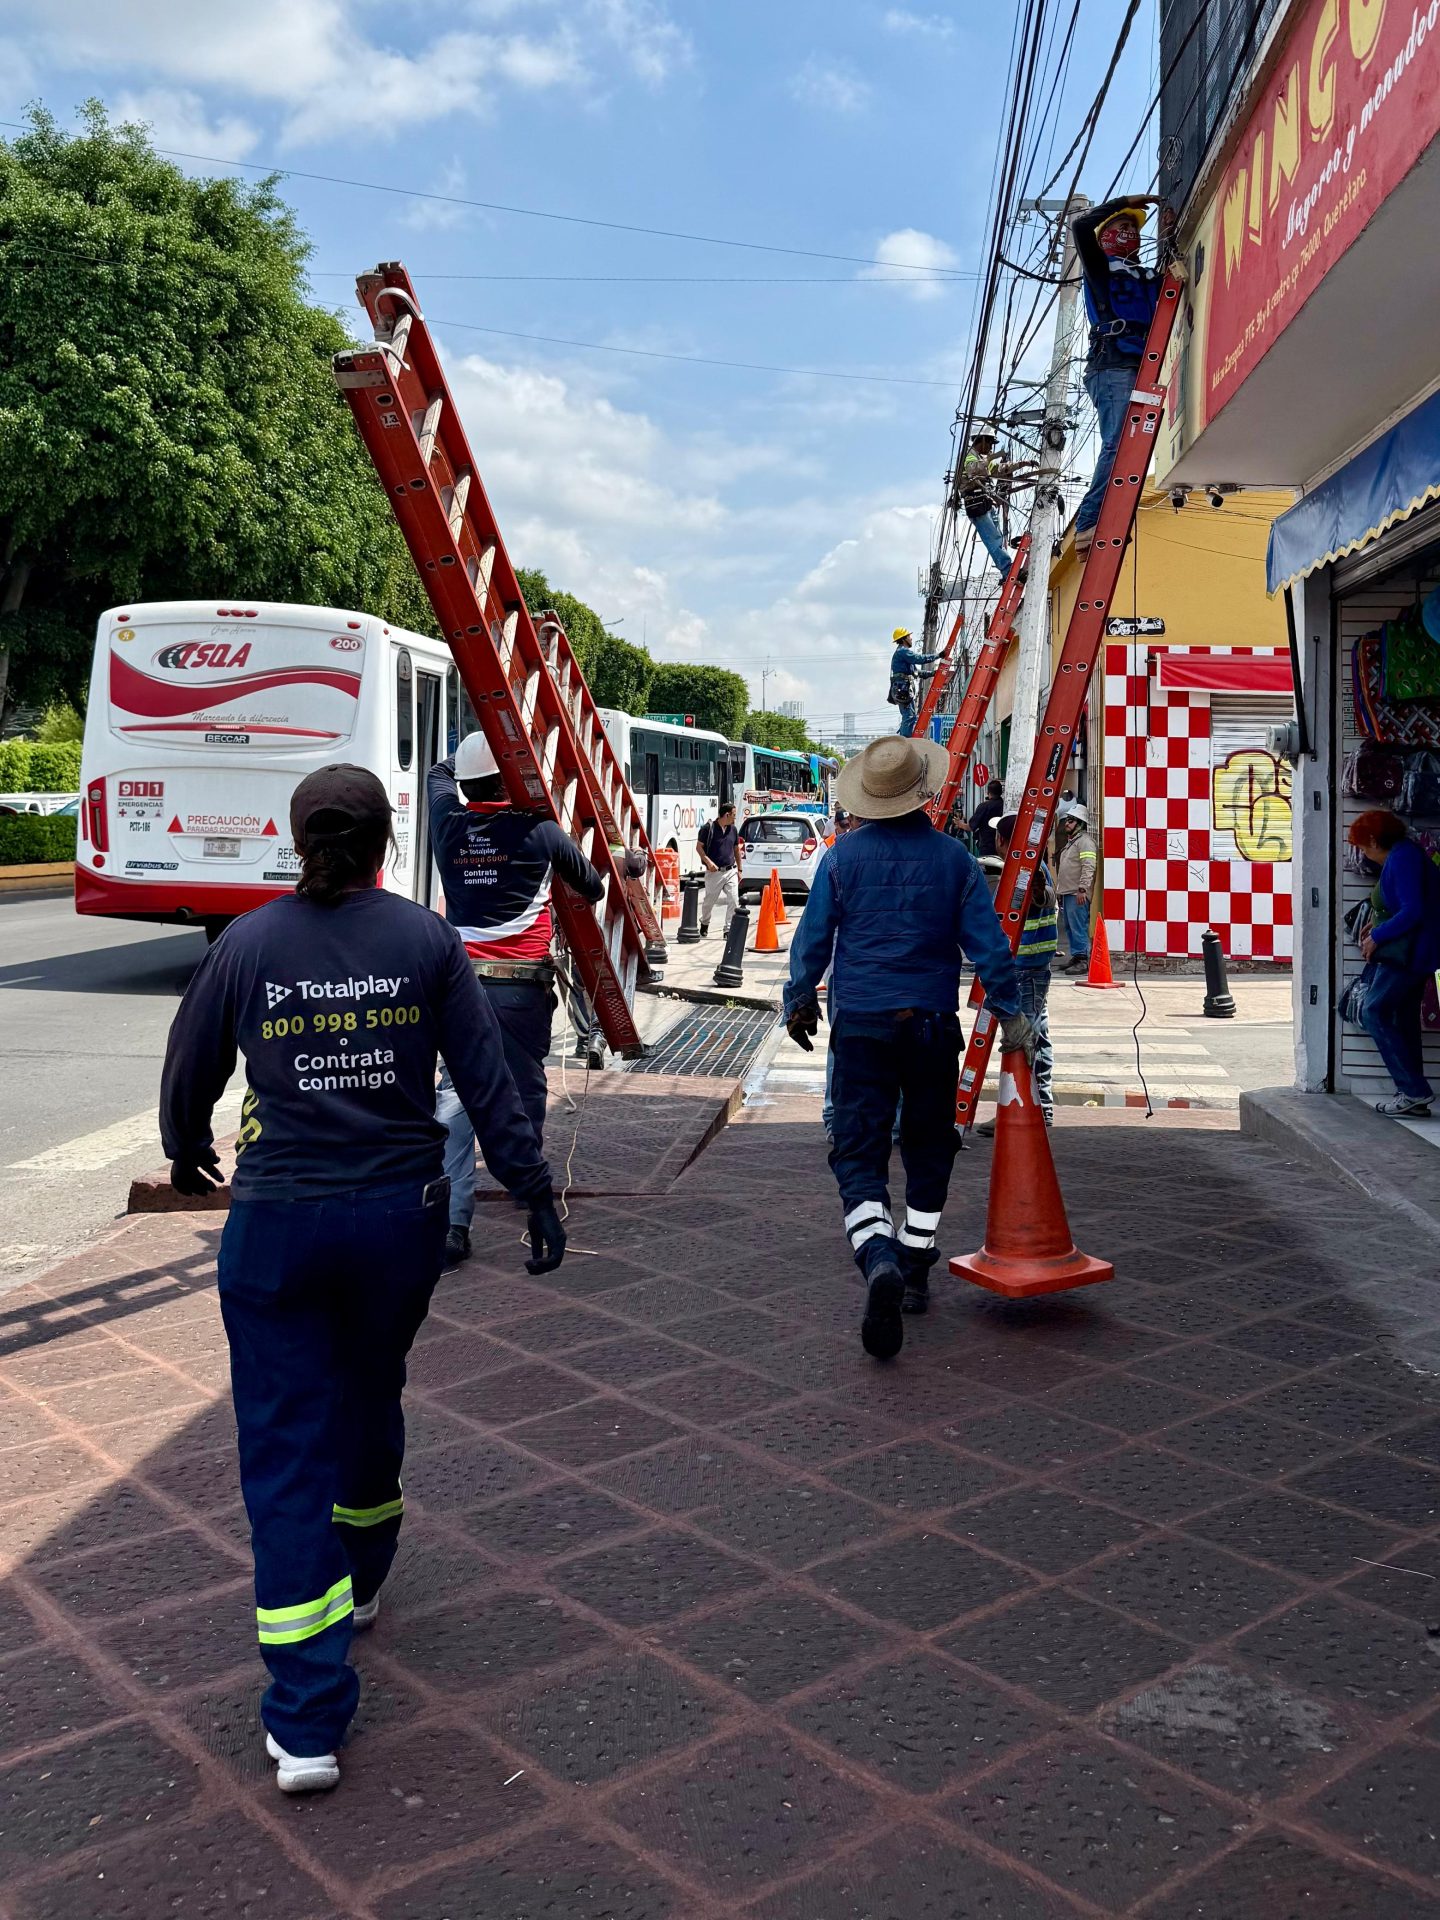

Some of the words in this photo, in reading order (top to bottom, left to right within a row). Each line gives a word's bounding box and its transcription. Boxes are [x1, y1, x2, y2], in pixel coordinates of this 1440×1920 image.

[1343, 124, 1357, 174] y
[1360, 0, 1440, 135] menudeo
[335, 639, 359, 650] 200
[191, 712, 235, 722] Marcando
[237, 712, 246, 722] la
[249, 713, 289, 725] diferencia
[207, 735, 247, 743] BECCAR
[121, 783, 160, 795] 911
[187, 813, 261, 827] PRECAUCIÓN
[673, 797, 705, 836] Qrobus
[219, 826, 260, 834] CONTINUAS
[277, 847, 300, 860] REPO
[276, 861, 288, 869] 442
[463, 869, 498, 877] Contrata
[464, 876, 498, 885] conmigo
[261, 1015, 304, 1040] 800
[313, 1011, 358, 1033] 998
[366, 1005, 420, 1029] 5000
[339, 1037, 348, 1046] o
[294, 1048, 394, 1072] Contrata
[298, 1069, 396, 1091] conmigo
